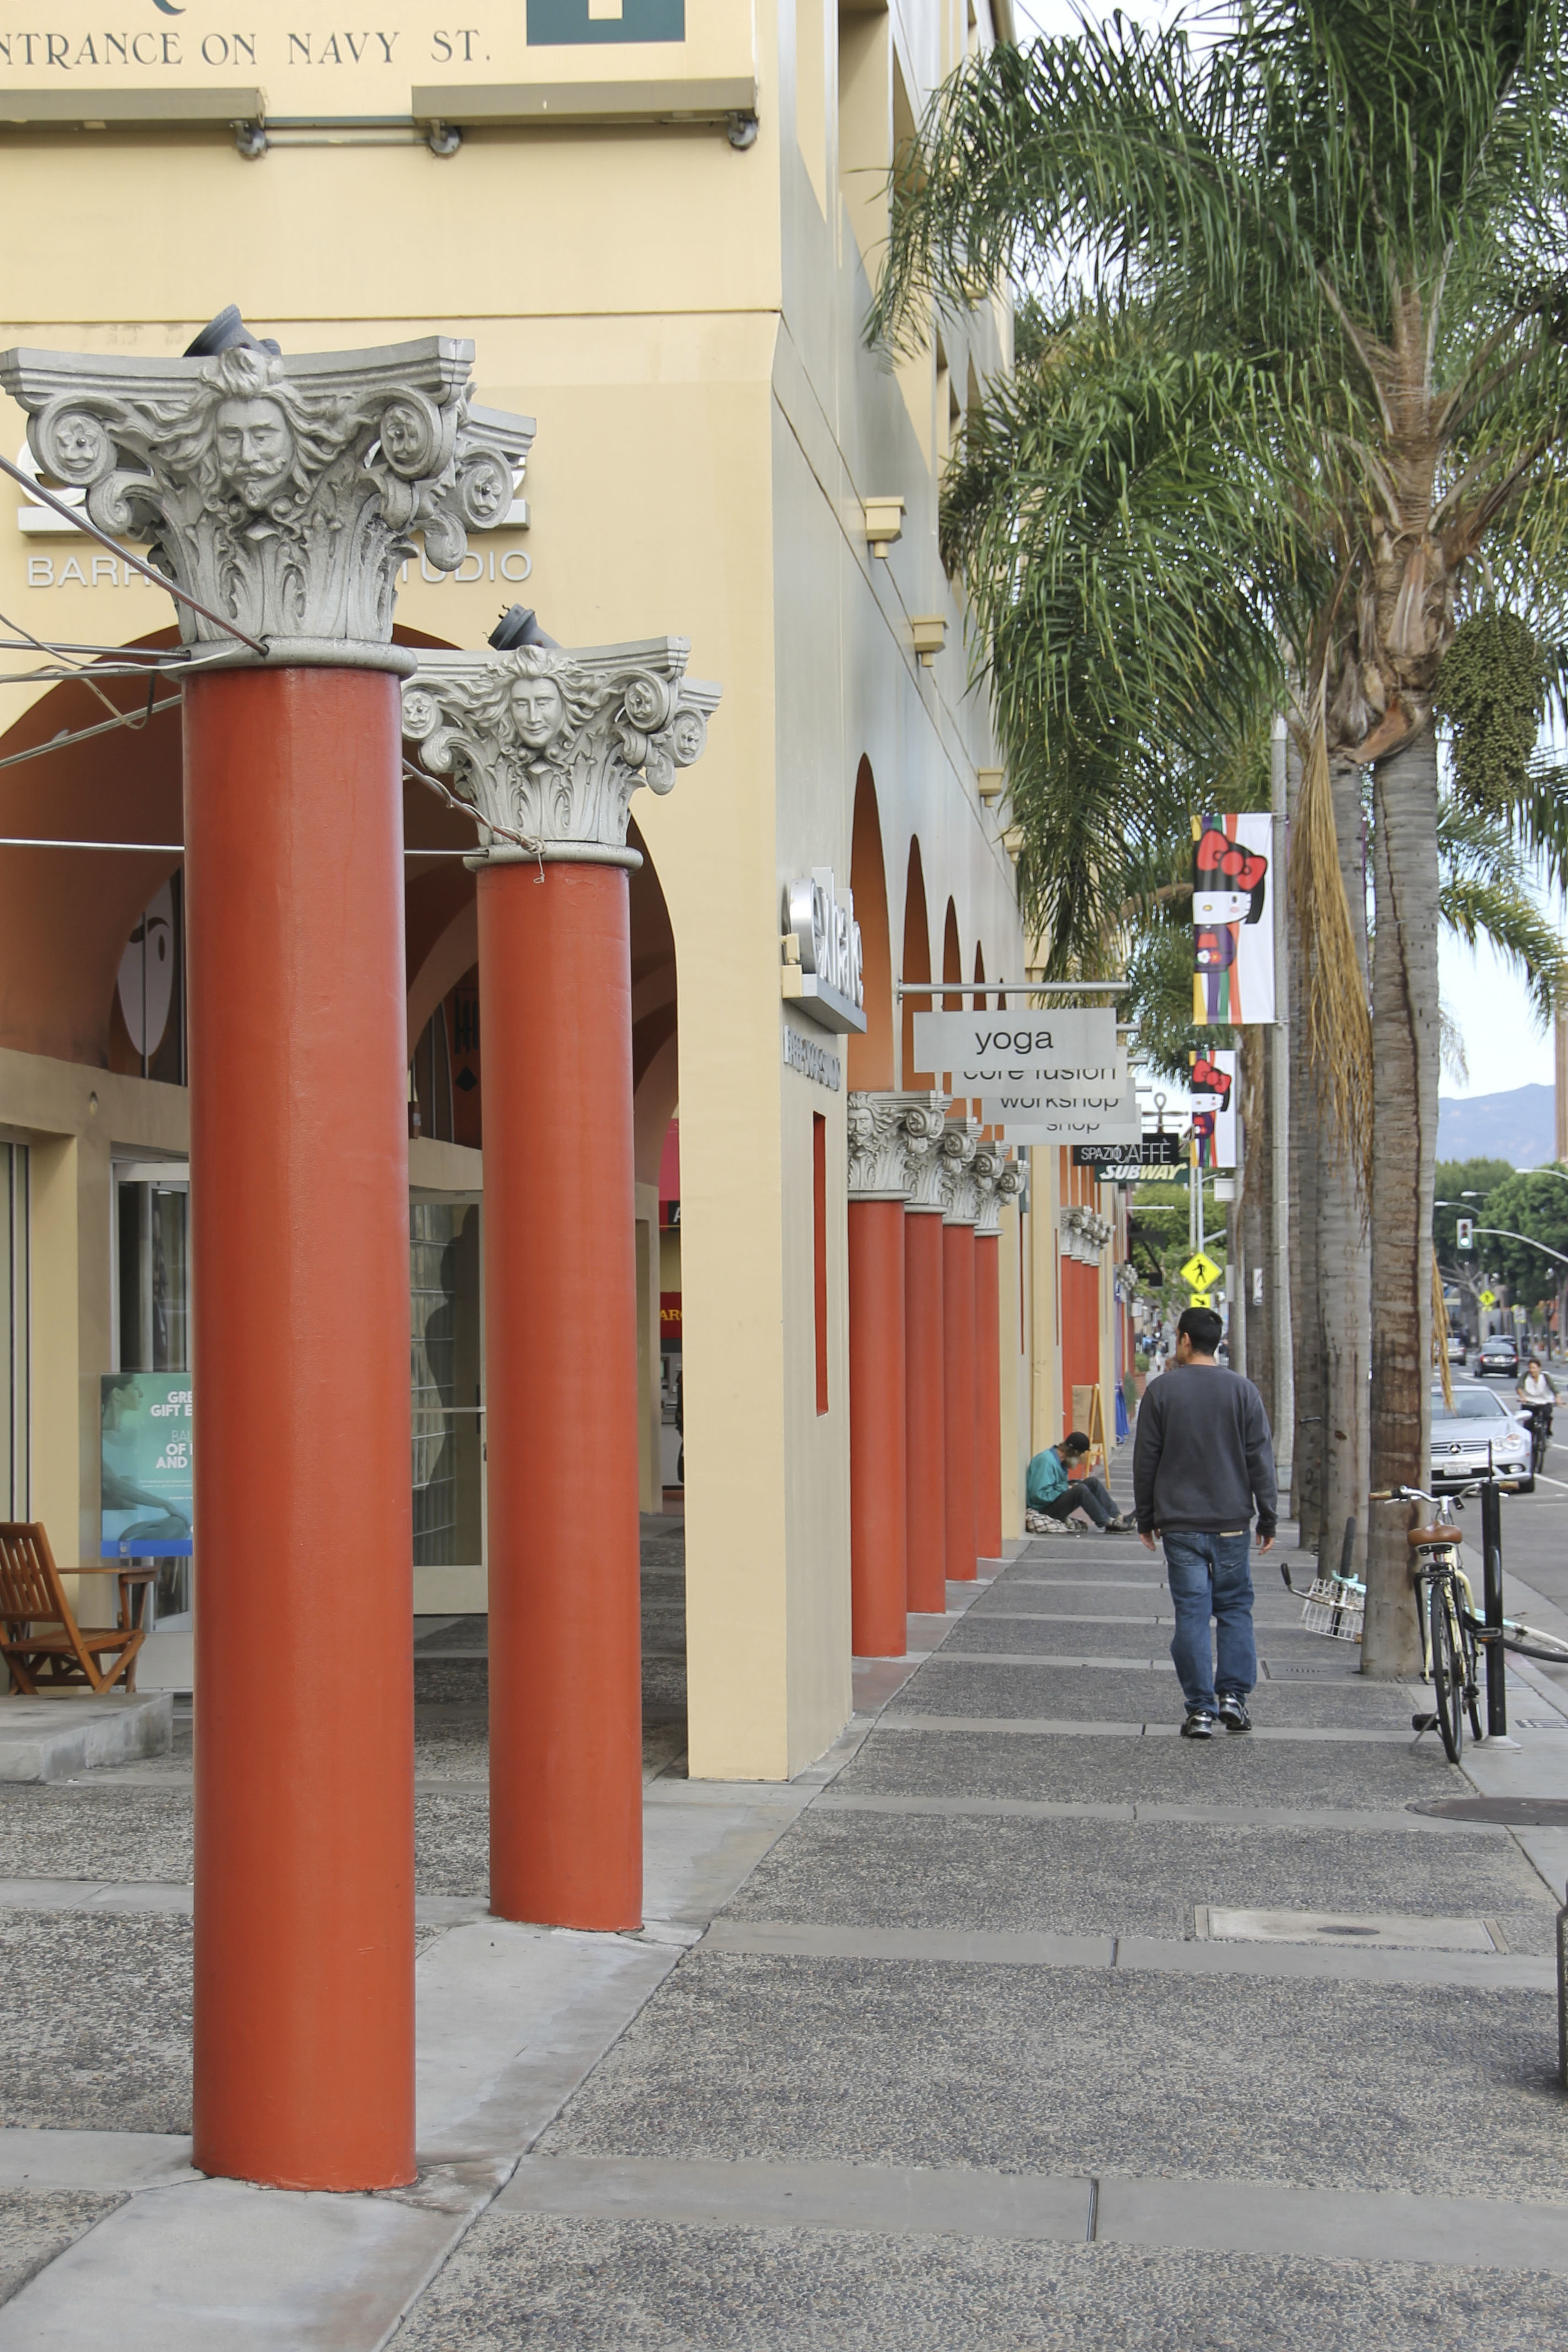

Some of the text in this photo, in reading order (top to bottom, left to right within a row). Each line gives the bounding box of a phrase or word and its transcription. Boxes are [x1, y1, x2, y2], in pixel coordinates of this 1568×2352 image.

[201, 33, 258, 66] ON
[287, 31, 400, 65] NAVY
[430, 29, 490, 63] ST.
[28, 556, 164, 588] BARR
[975, 1031, 1054, 1055] yoga
[1099, 1162, 1189, 1181] SUBWAY
[151, 1404, 181, 1417] GIFT
[166, 1443, 186, 1456] OF
[156, 1456, 188, 1469] AND
